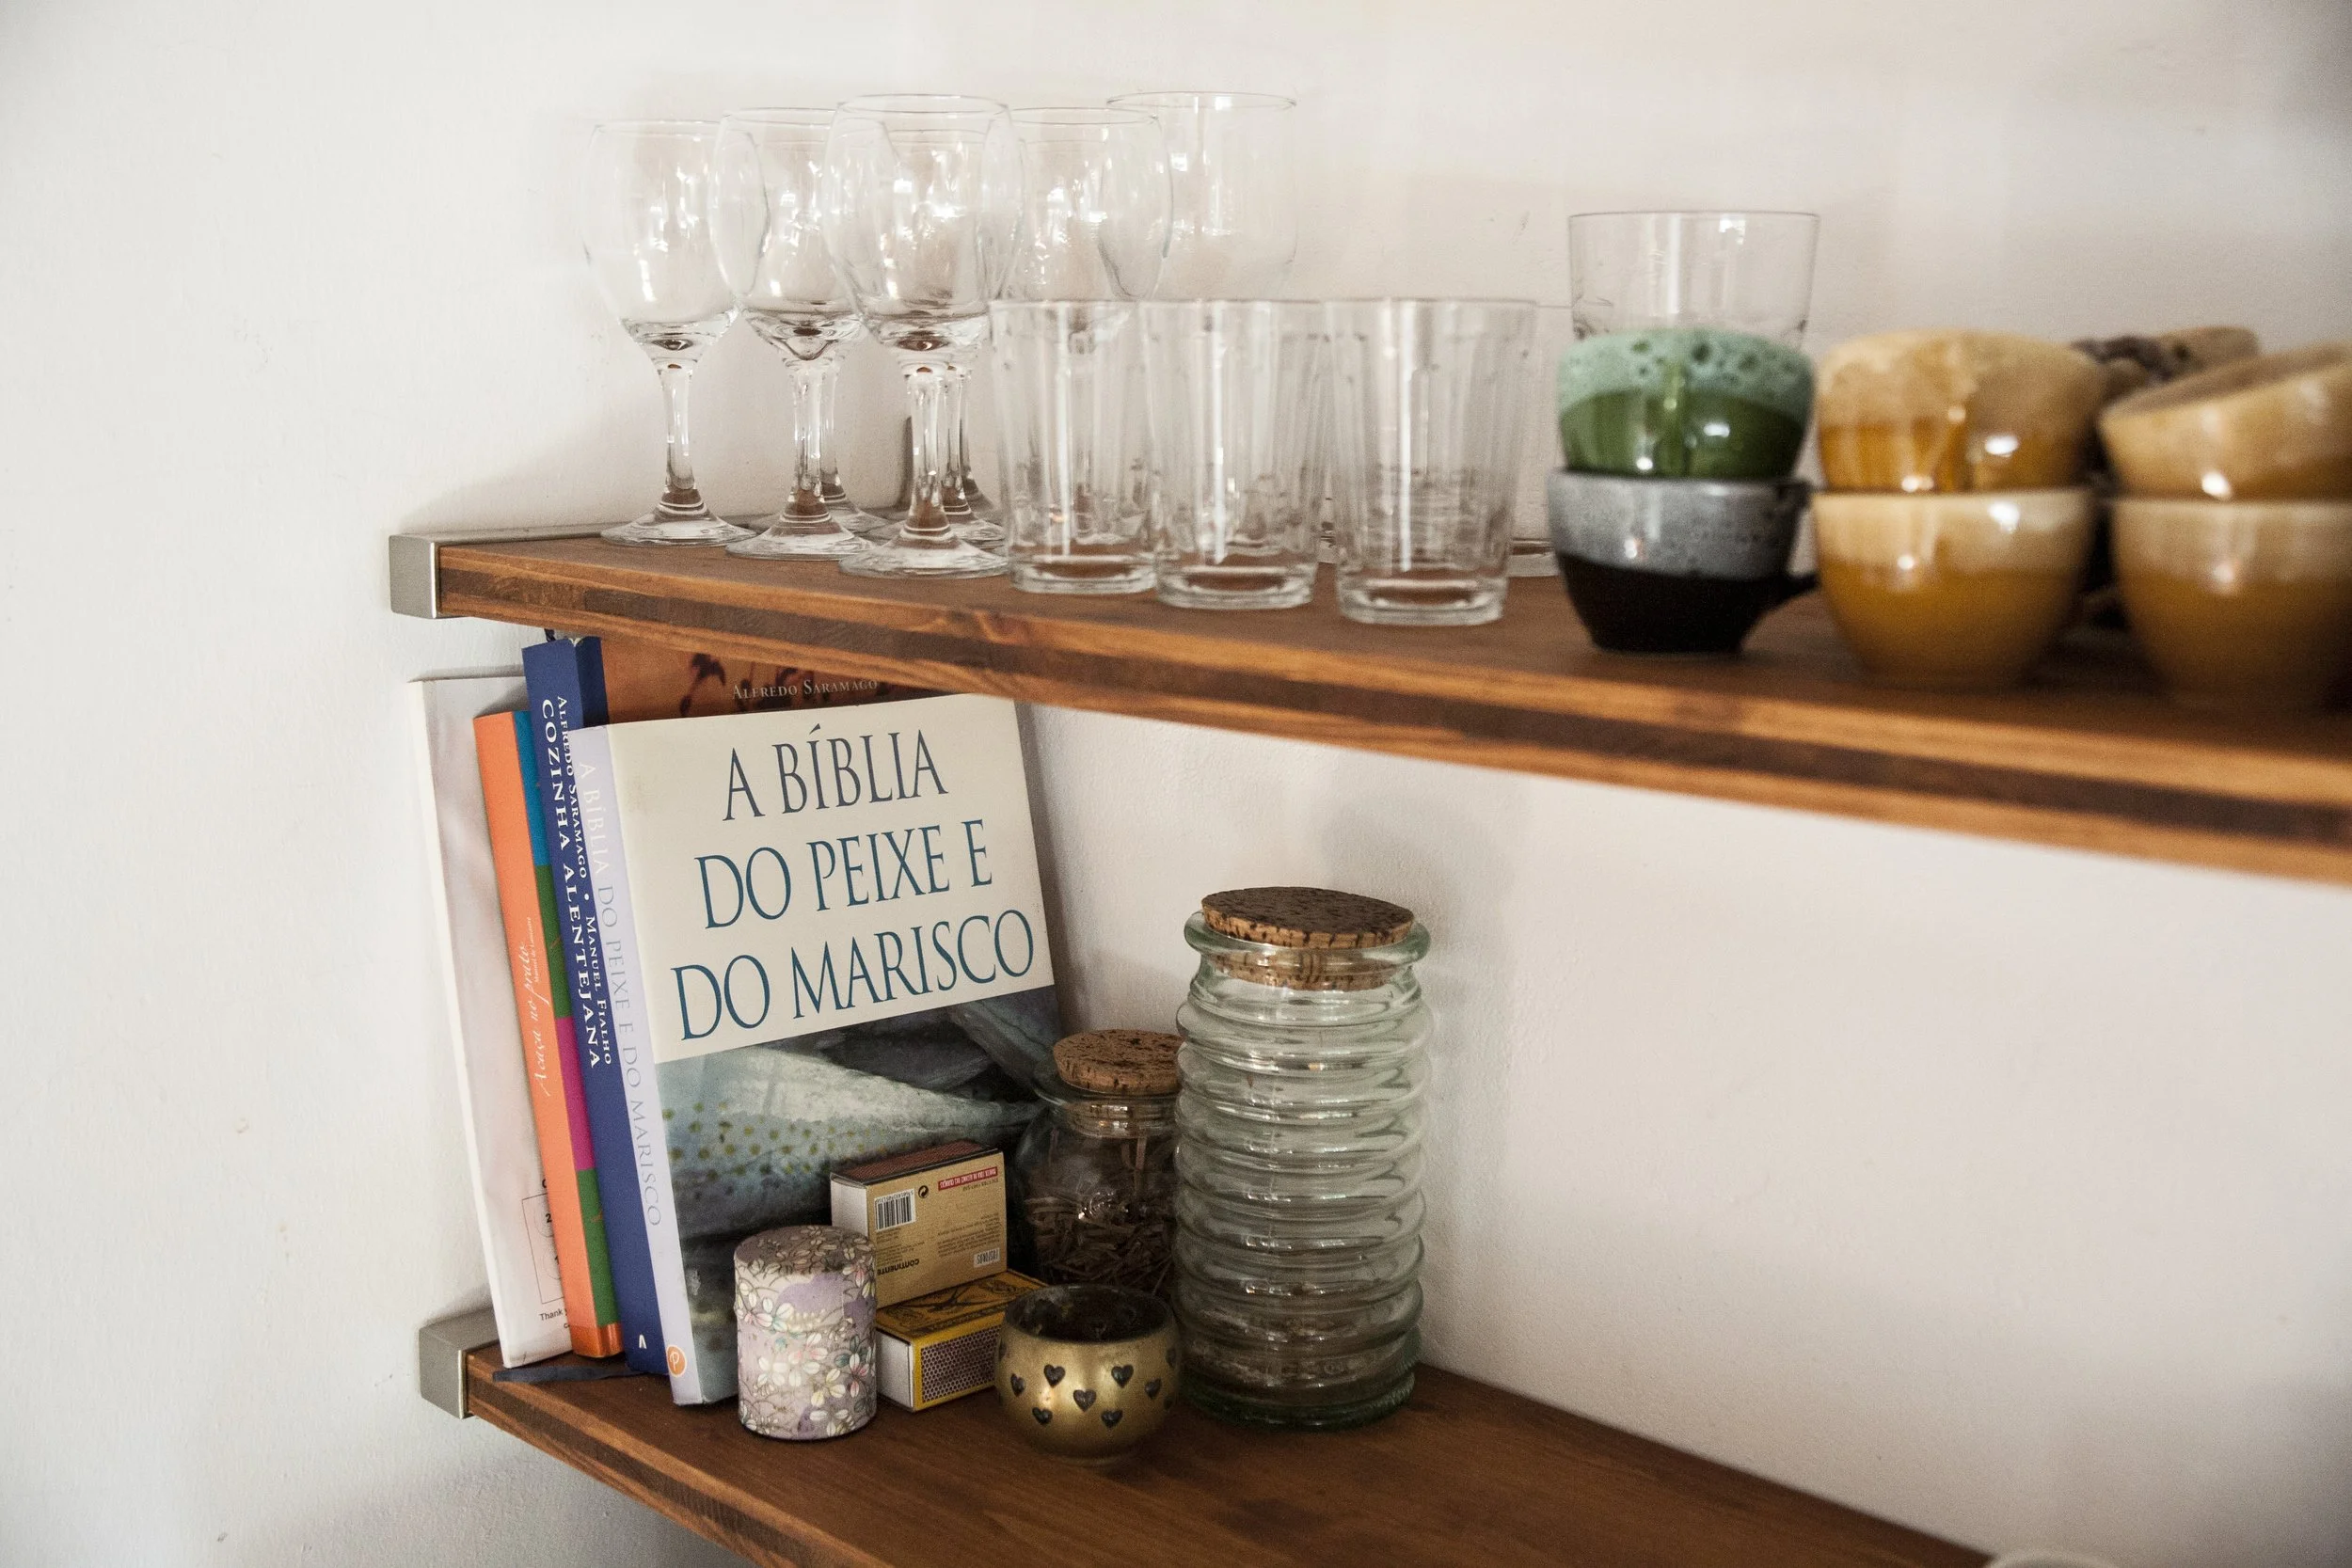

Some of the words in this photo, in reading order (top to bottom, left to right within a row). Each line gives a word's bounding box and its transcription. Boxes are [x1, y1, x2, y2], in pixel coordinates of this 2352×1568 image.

[580, 763, 596, 779] A
[723, 747, 766, 821] A
[771, 723, 948, 815] BÍBLIA
[583, 790, 610, 875] BÍBLIA
[694, 847, 791, 929] DO
[806, 824, 950, 911] PEIXE
[961, 818, 993, 887] E
[542, 699, 570, 850] COZINHA
[564, 863, 600, 1069] ALENTEJANA
[598, 886, 617, 927] DO
[586, 916, 603, 991] MANUEL
[596, 1000, 612, 1065] FIALHO
[606, 941, 630, 1010] PEIXE
[670, 955, 770, 1040] DO
[790, 909, 1034, 1020] MARISCO
[619, 1022, 634, 1034] E
[623, 1047, 642, 1087] DO
[630, 1100, 661, 1226] MARISCO
[539, 1308, 563, 1321] Thank
